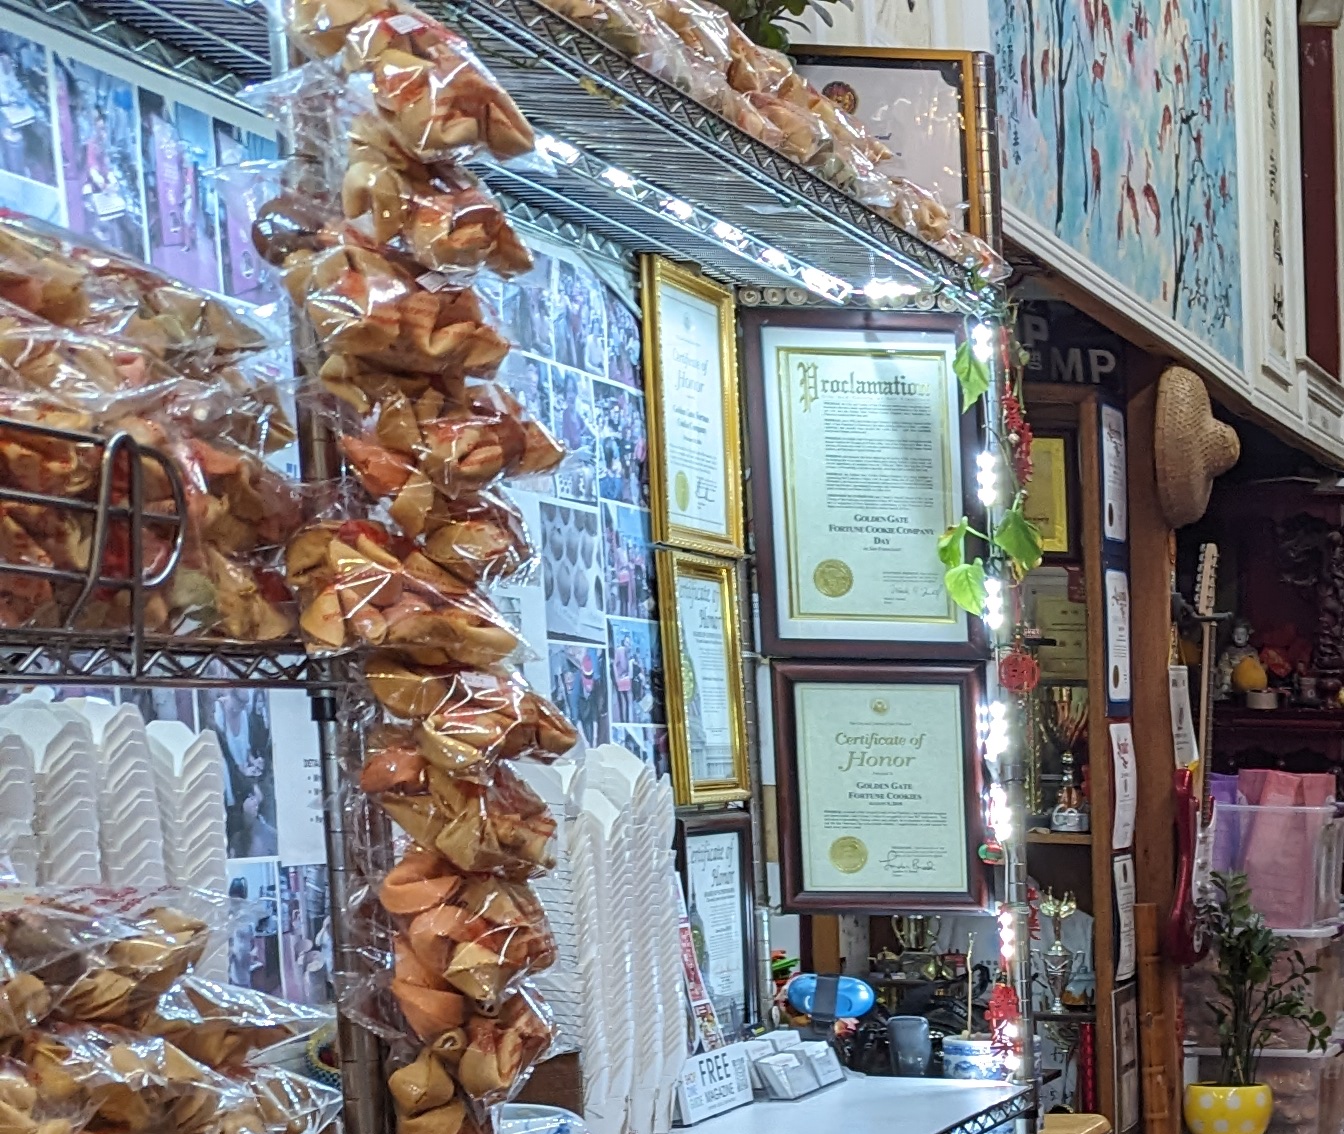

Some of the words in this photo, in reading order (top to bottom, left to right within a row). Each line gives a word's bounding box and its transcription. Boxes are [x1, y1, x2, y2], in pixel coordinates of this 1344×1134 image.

[835, 732, 907, 749] Certificate
[910, 733, 927, 750] of
[838, 751, 916, 772] Honor
[698, 1052, 731, 1086] FREE
